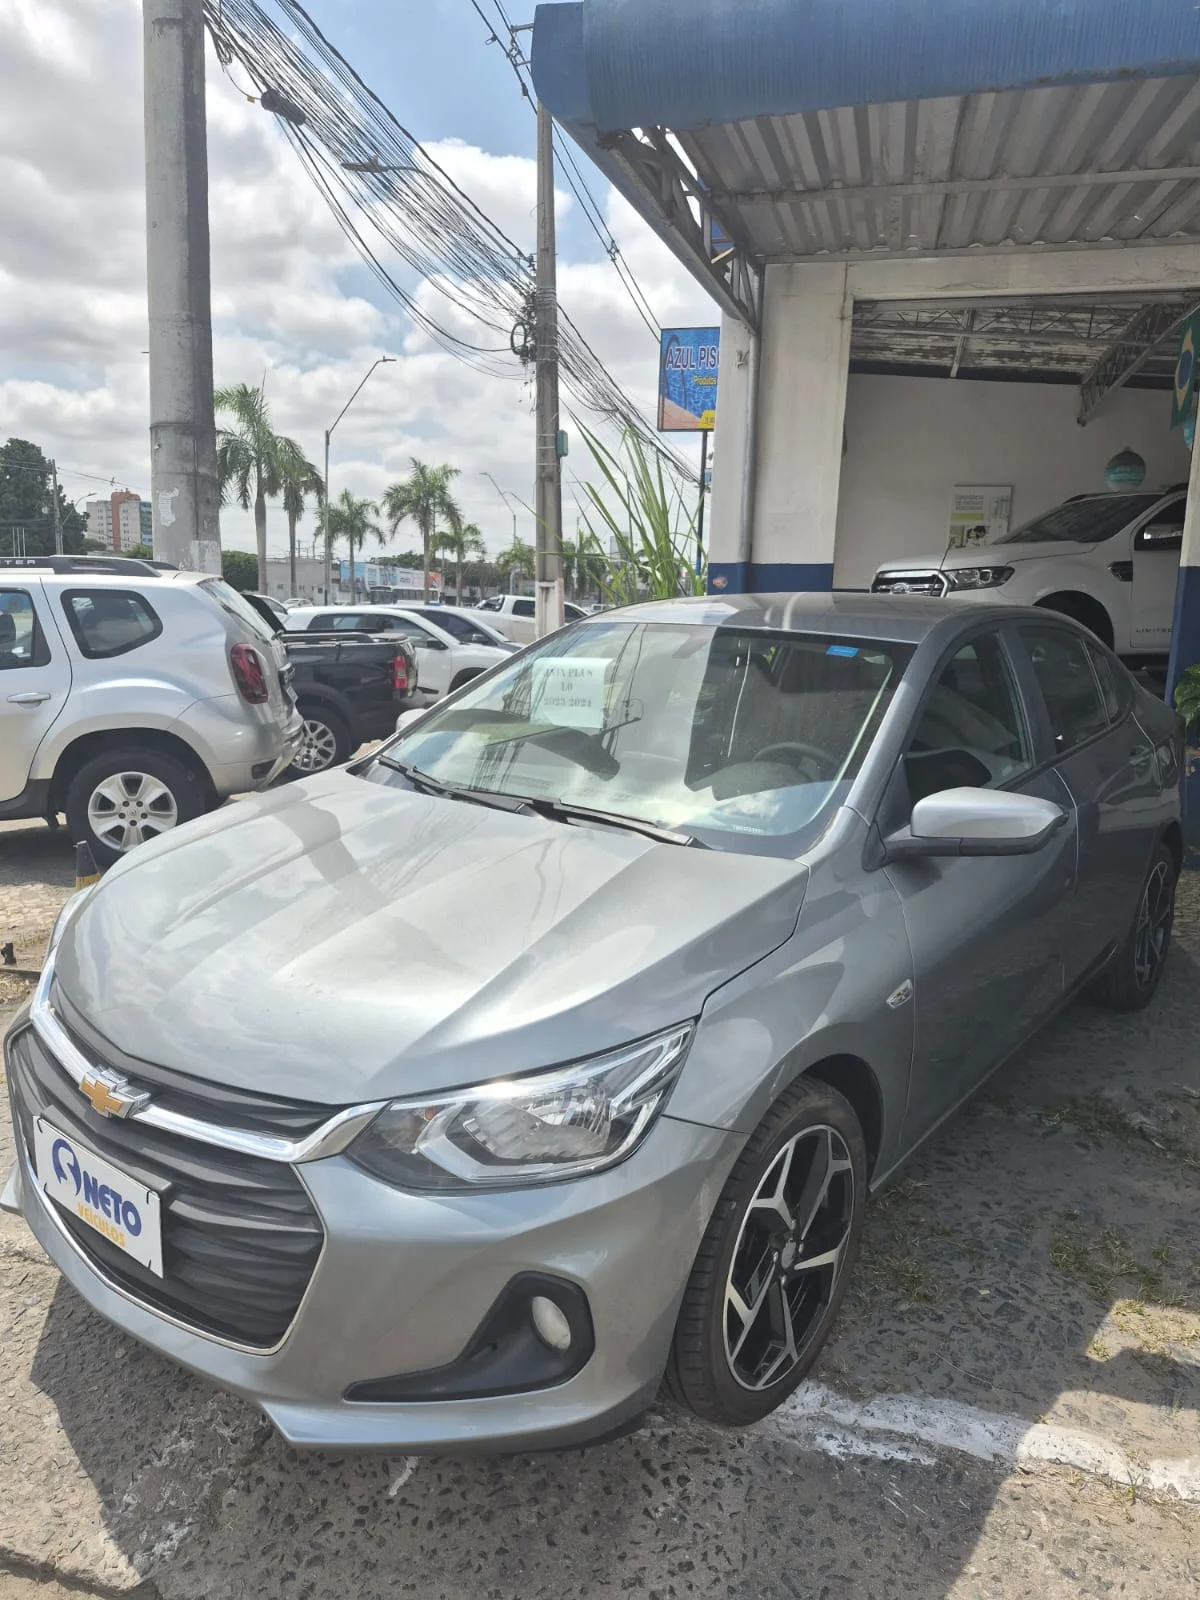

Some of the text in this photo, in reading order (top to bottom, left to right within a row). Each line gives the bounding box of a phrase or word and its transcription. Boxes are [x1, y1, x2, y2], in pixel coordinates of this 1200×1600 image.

[666, 346, 720, 370] AZUL PIS
[82, 1170, 142, 1237] NETO
